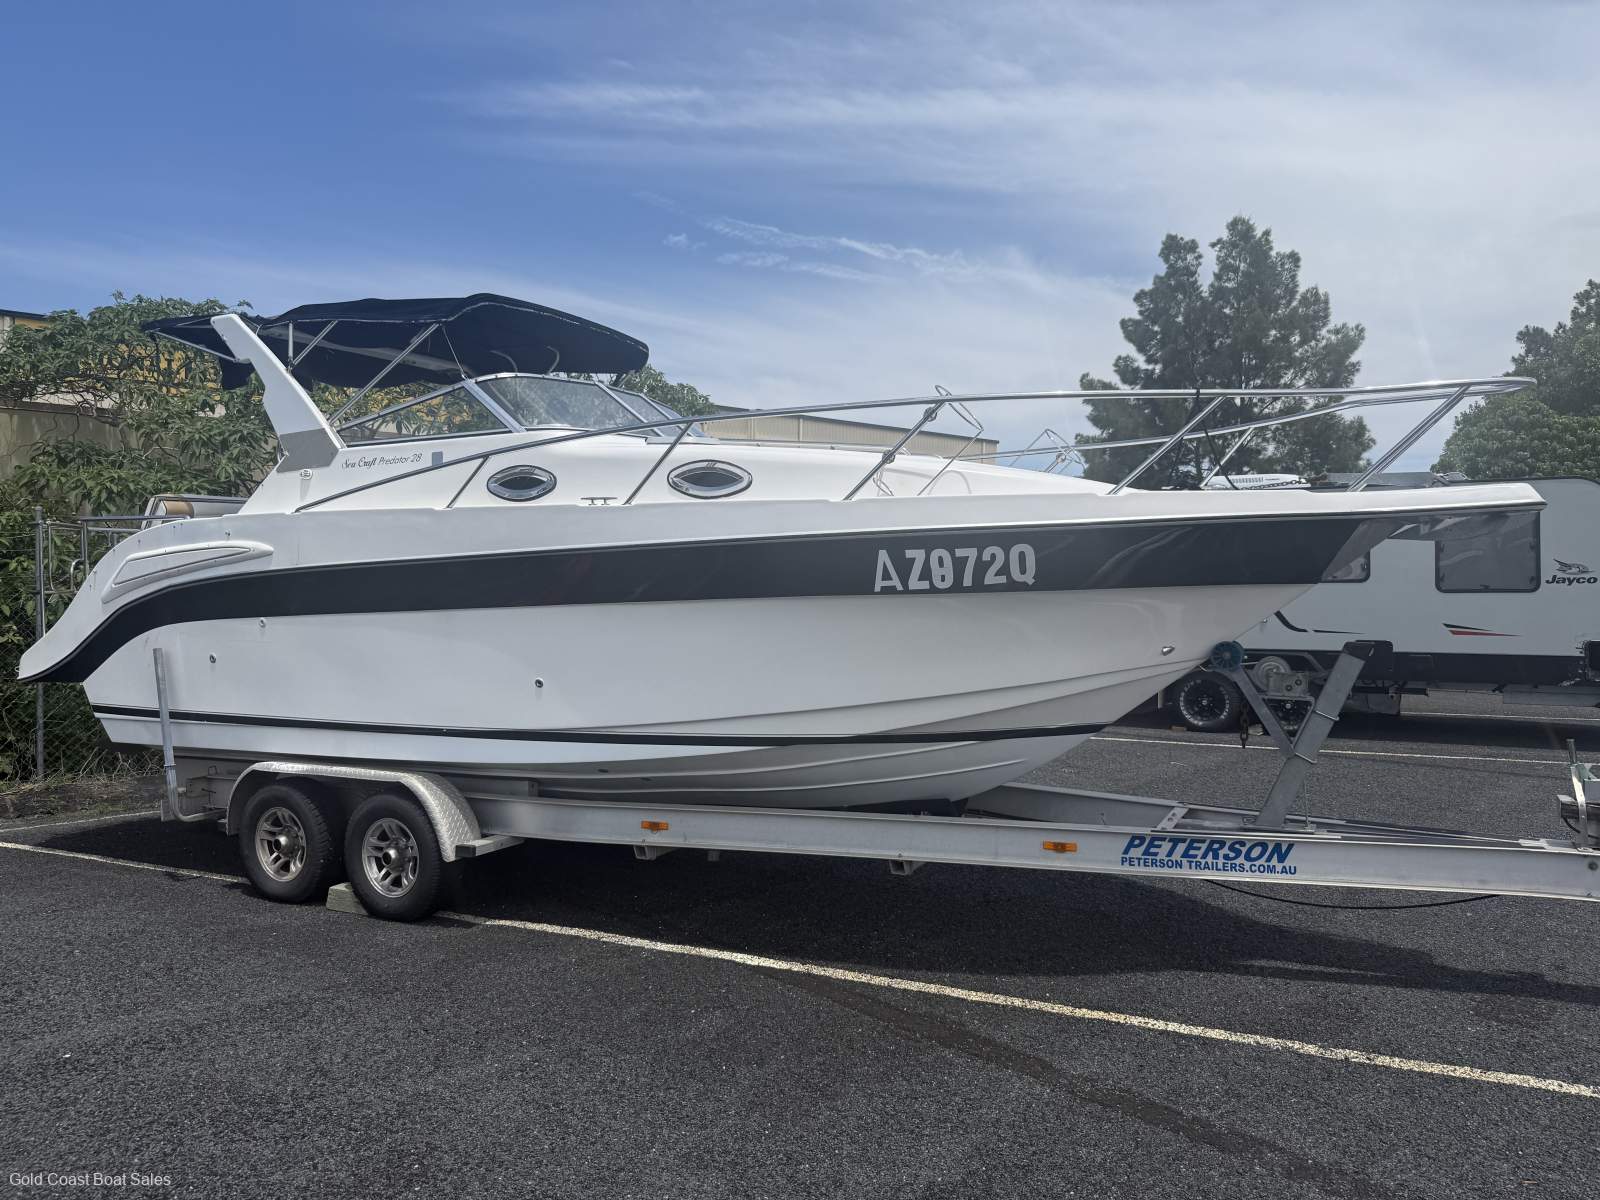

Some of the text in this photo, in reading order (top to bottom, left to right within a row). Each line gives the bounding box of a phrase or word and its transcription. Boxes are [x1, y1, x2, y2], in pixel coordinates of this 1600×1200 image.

[358, 456, 378, 469] Craft
[378, 455, 409, 465] Predator
[410, 453, 423, 463] 28
[1545, 575, 1599, 586] Jayco
[1122, 835, 1295, 864] PETERSON
[1121, 856, 1297, 876] PETERSON TRAILERS.COM.AU
